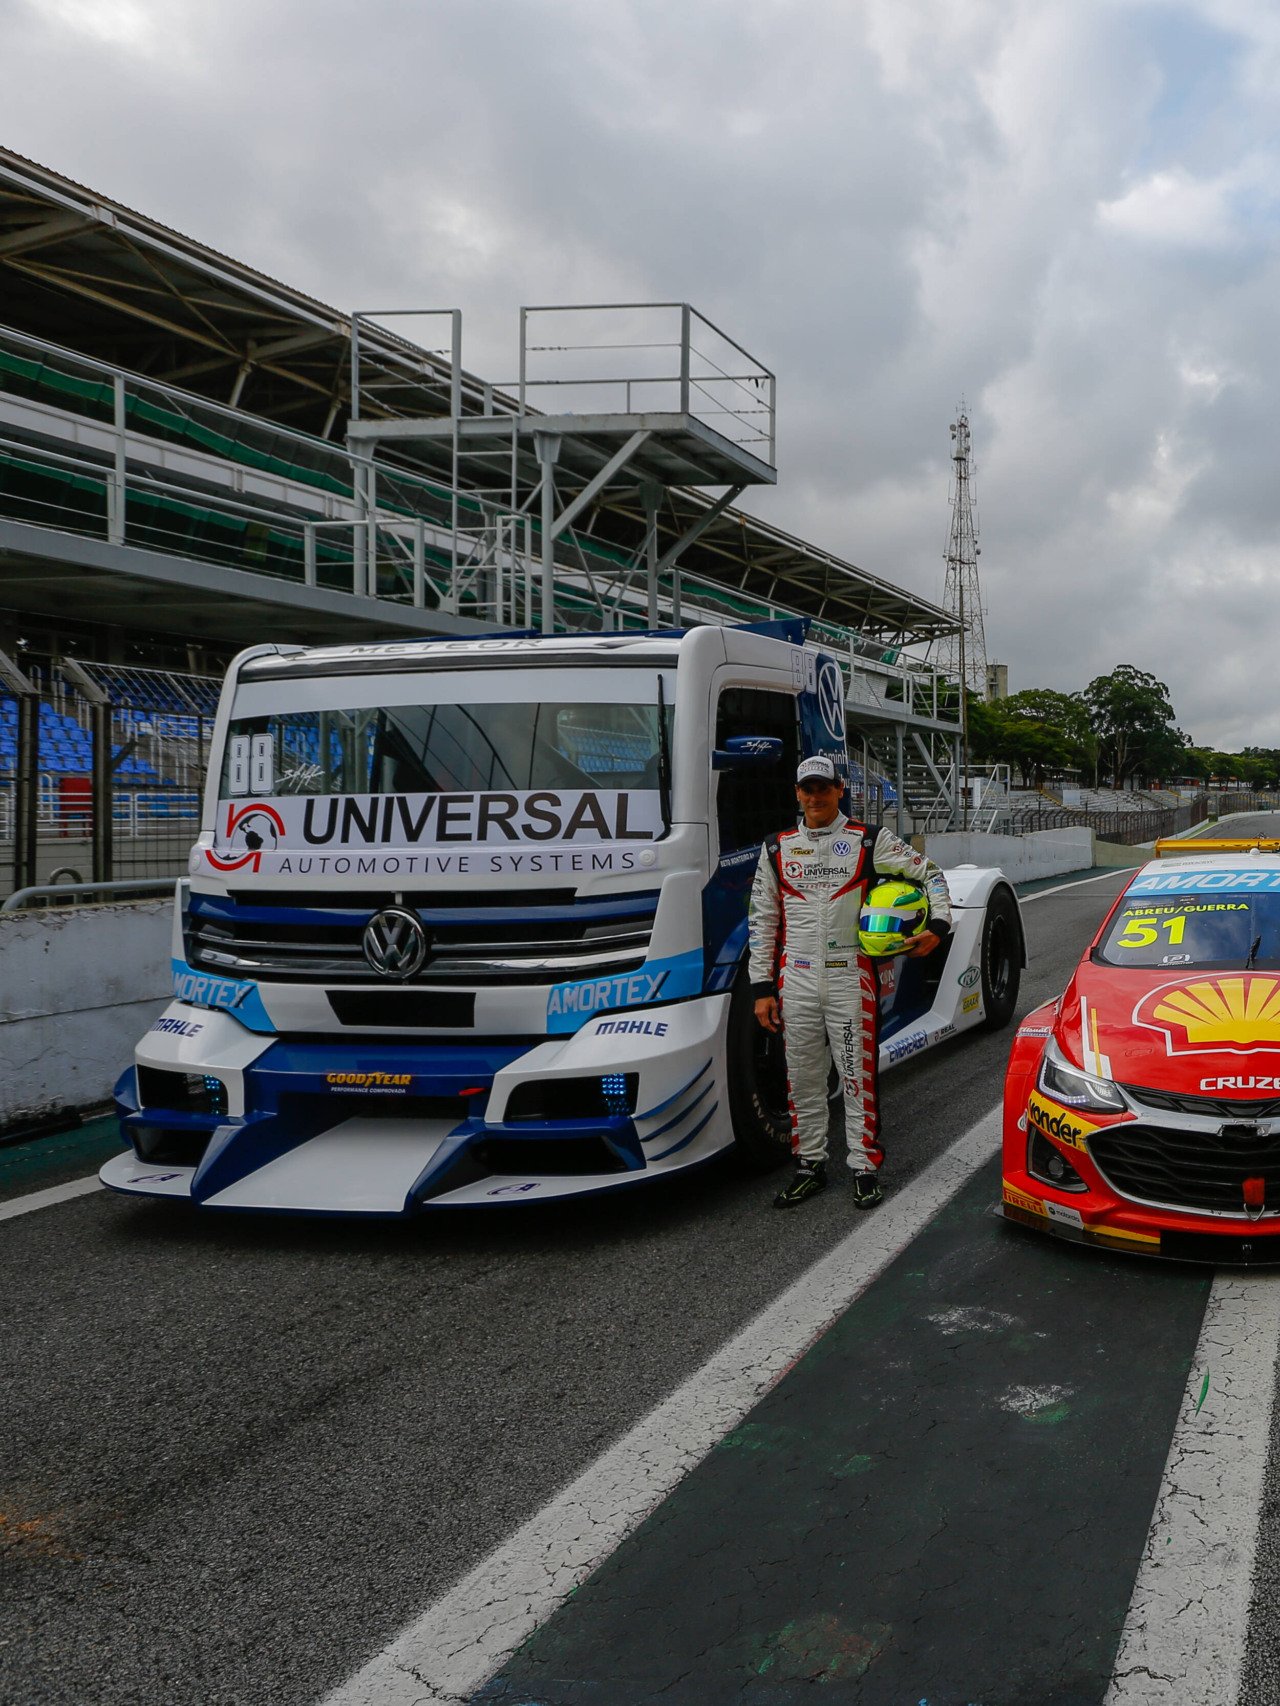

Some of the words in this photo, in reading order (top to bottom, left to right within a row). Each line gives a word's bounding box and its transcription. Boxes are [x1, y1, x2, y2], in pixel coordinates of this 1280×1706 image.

[350, 640, 542, 654] METEOR
[229, 732, 275, 796] 88
[302, 792, 655, 844] UNIVERSAL
[278, 856, 470, 874] AUTOMOTIVE
[489, 852, 635, 872] SYSTEMS
[803, 867, 850, 876] UNIVERSAL
[1122, 903, 1250, 917] ABREU/GUERRA
[1117, 915, 1187, 949] 51
[547, 970, 671, 1015] AMORTEX
[595, 1020, 669, 1037] MAHLE
[843, 1018, 853, 1076] UNIVERSAL
[326, 1071, 412, 1087] GOODYEAR
[1029, 1098, 1083, 1148] vonder
[1004, 1189, 1045, 1215] PIRELLI
[1055, 1209, 1081, 1223] motorola
